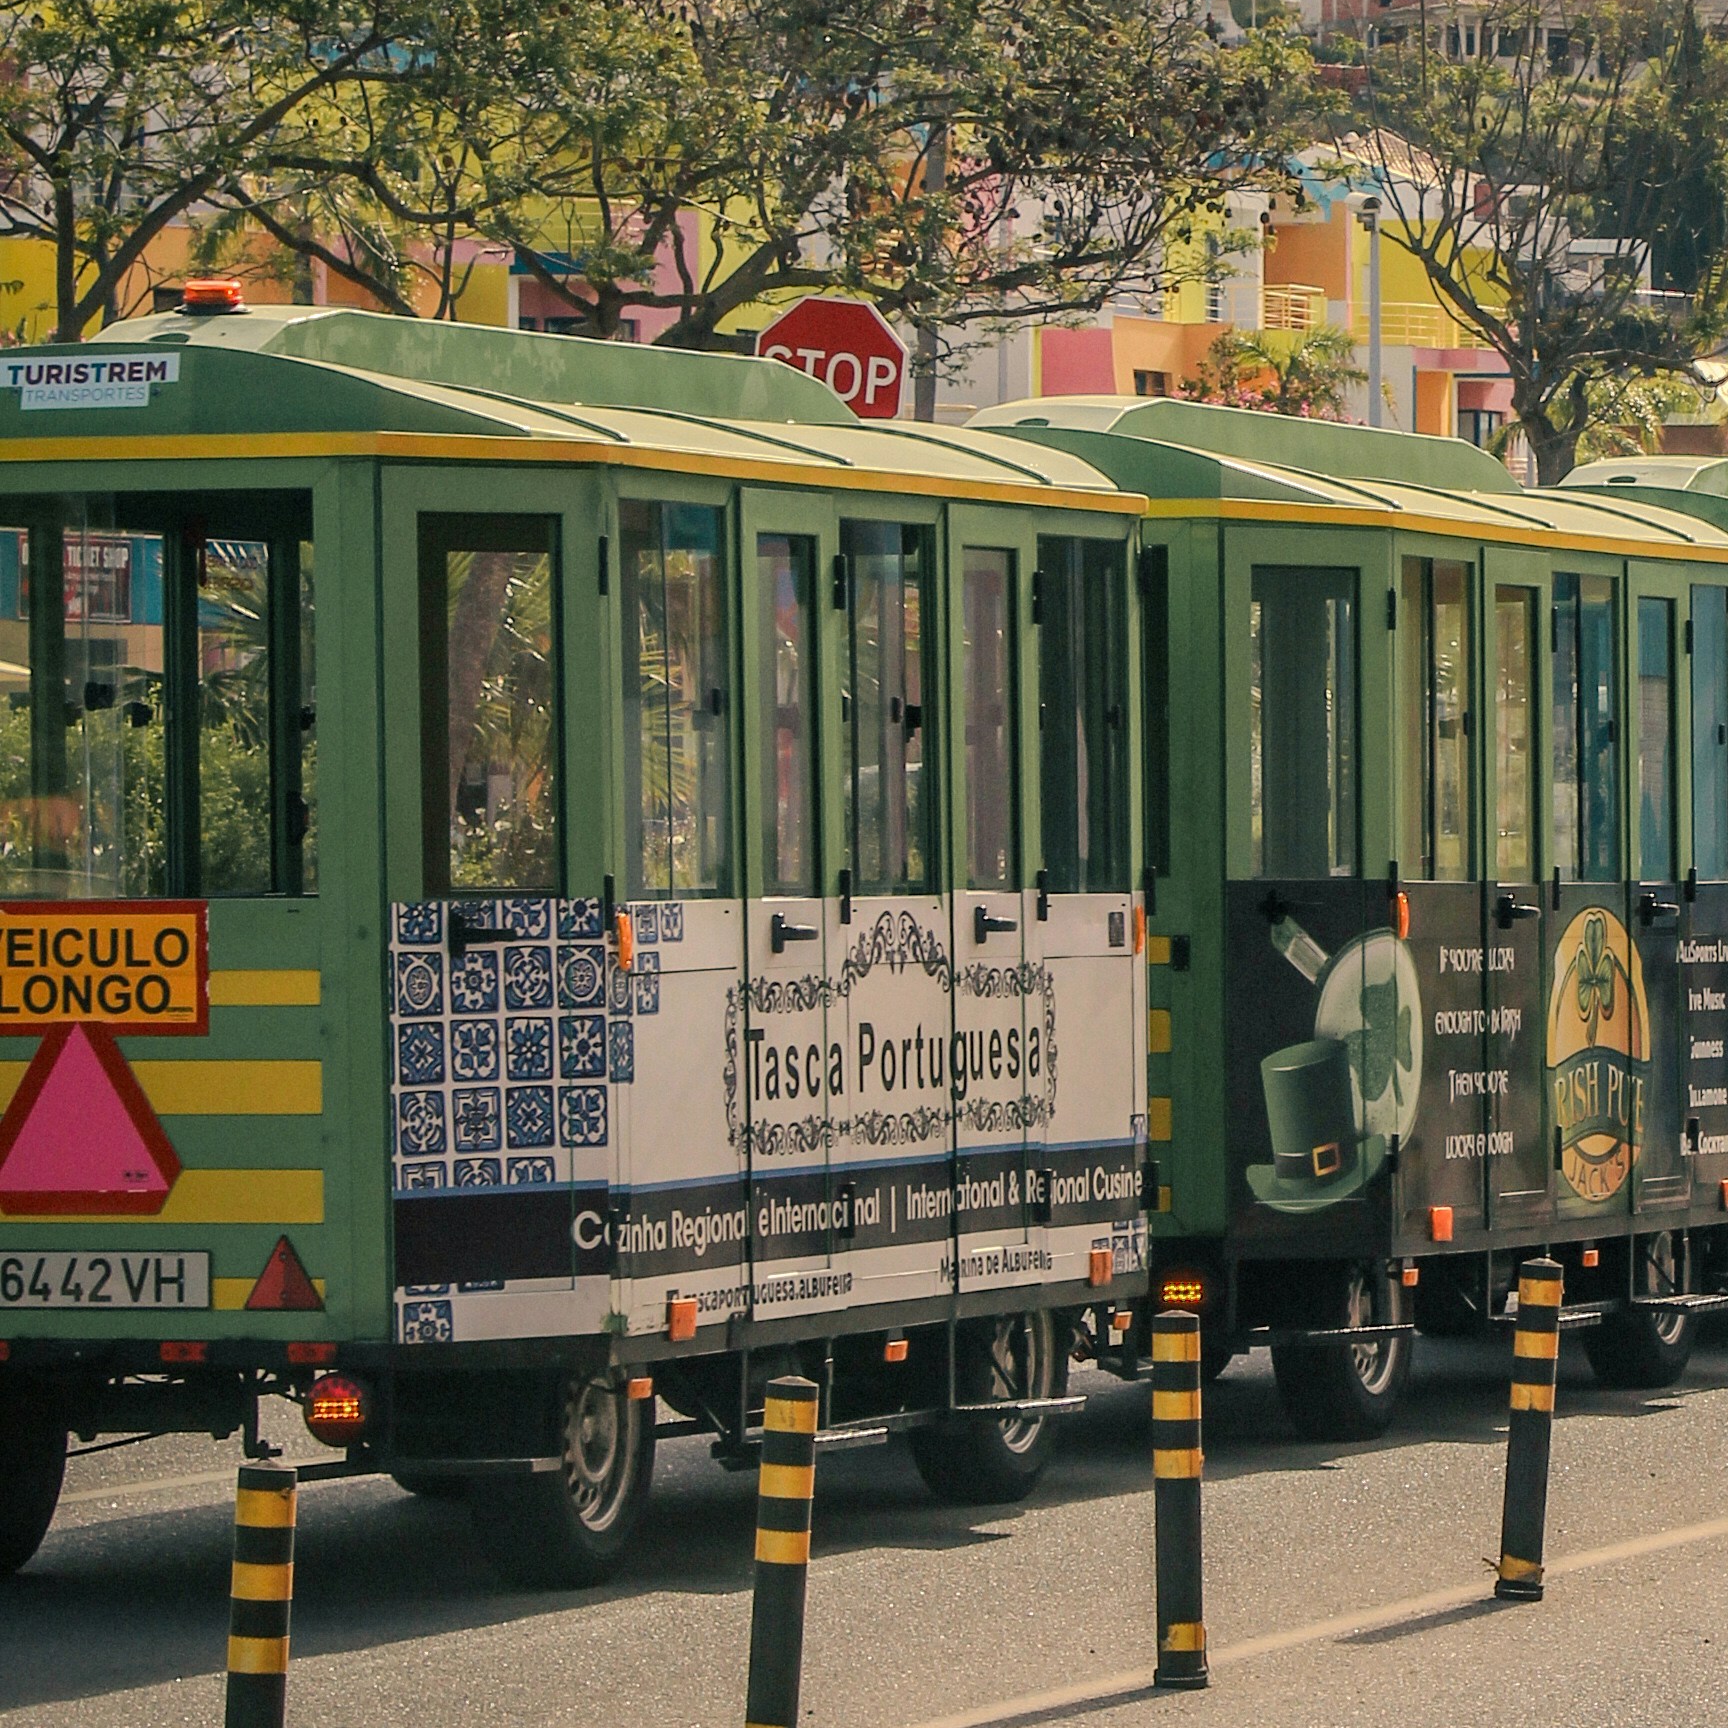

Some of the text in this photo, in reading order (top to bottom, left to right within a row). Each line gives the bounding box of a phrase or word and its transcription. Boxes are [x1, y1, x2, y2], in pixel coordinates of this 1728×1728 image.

[8, 361, 167, 385] TURISTREM
[765, 345, 897, 404] TOP
[25, 387, 145, 402] TRANSPORTES
[0, 927, 190, 968] EICULO
[743, 1022, 1041, 1101] Tasca Portuguesa
[1554, 1061, 1600, 1130] RISH
[1025, 1165, 1090, 1207] Reional
